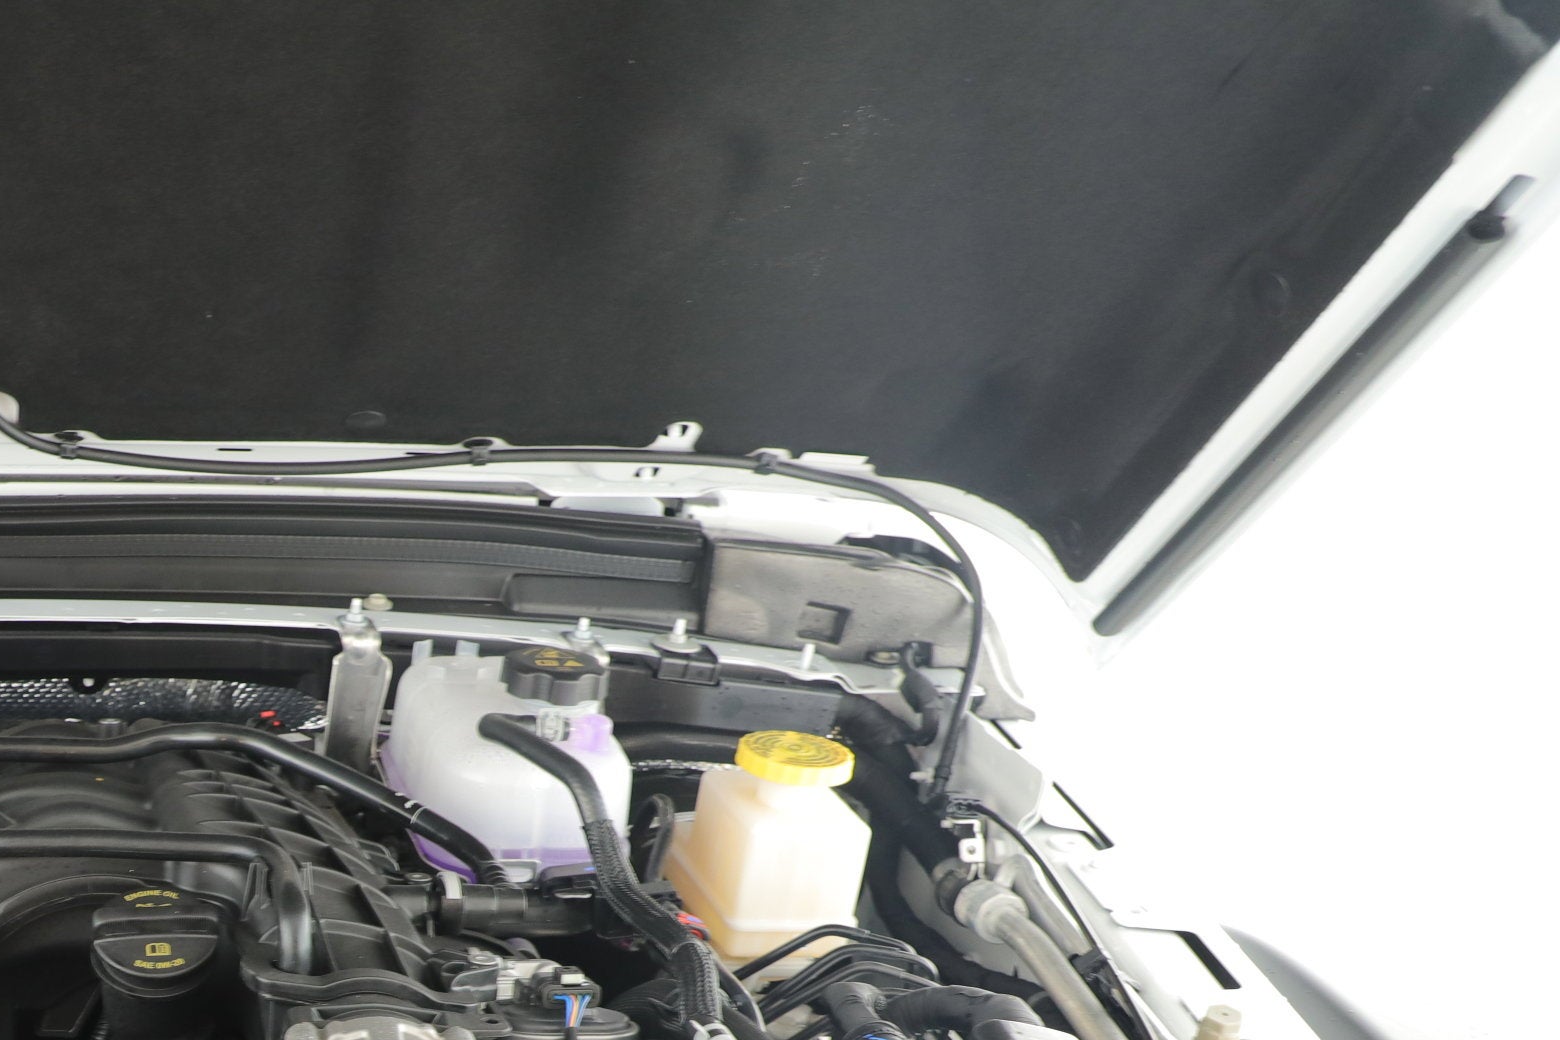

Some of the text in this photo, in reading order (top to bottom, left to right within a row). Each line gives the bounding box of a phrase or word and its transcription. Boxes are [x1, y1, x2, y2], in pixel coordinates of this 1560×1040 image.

[123, 890, 180, 902] ENGINE OIL
[133, 960, 155, 969] SAE
